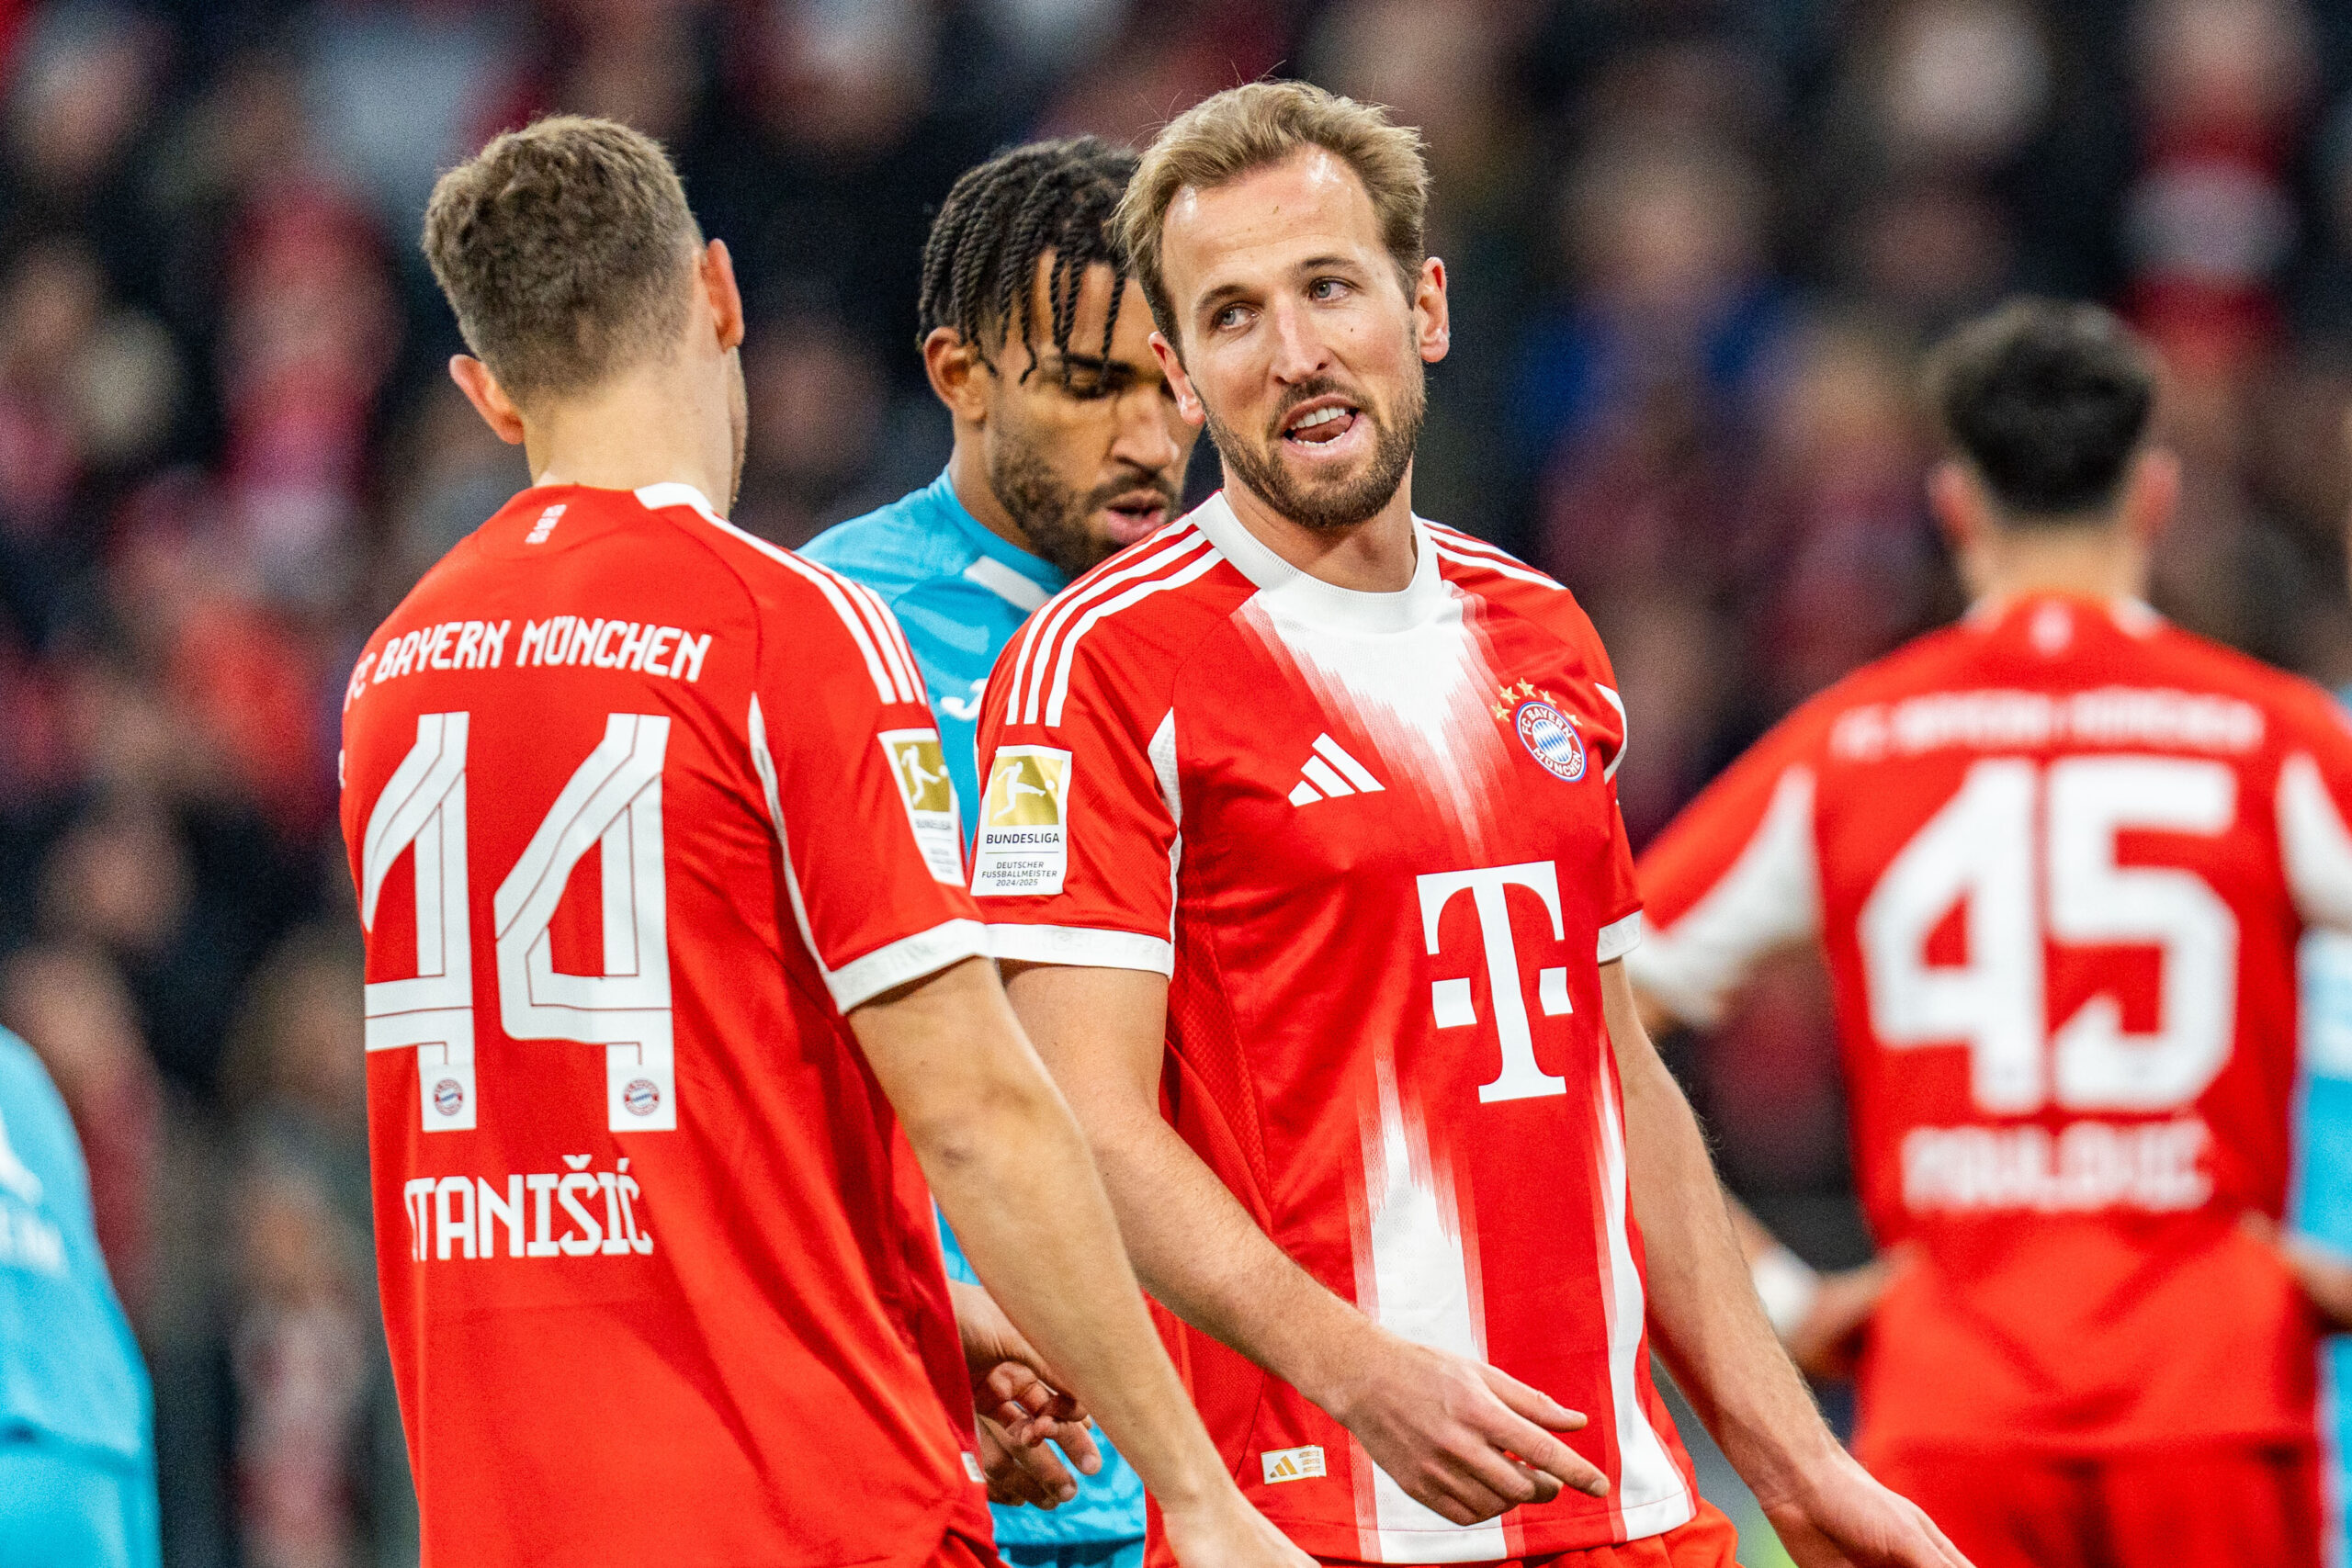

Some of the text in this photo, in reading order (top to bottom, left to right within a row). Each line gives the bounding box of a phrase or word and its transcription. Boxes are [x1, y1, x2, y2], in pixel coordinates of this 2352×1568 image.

[372, 619, 512, 685] BAYERN
[515, 615, 712, 682] MÜNCHEN
[1521, 707, 1573, 739] FC BAYERN
[982, 870, 1057, 878] FUSSBALLMEISTER
[986, 833, 1060, 844] BUNDESLIGA
[362, 711, 676, 1133] 44
[1858, 758, 2239, 1112] 45
[1416, 860, 1567, 1104] T
[403, 1154, 654, 1263] TANIŠIĆ
